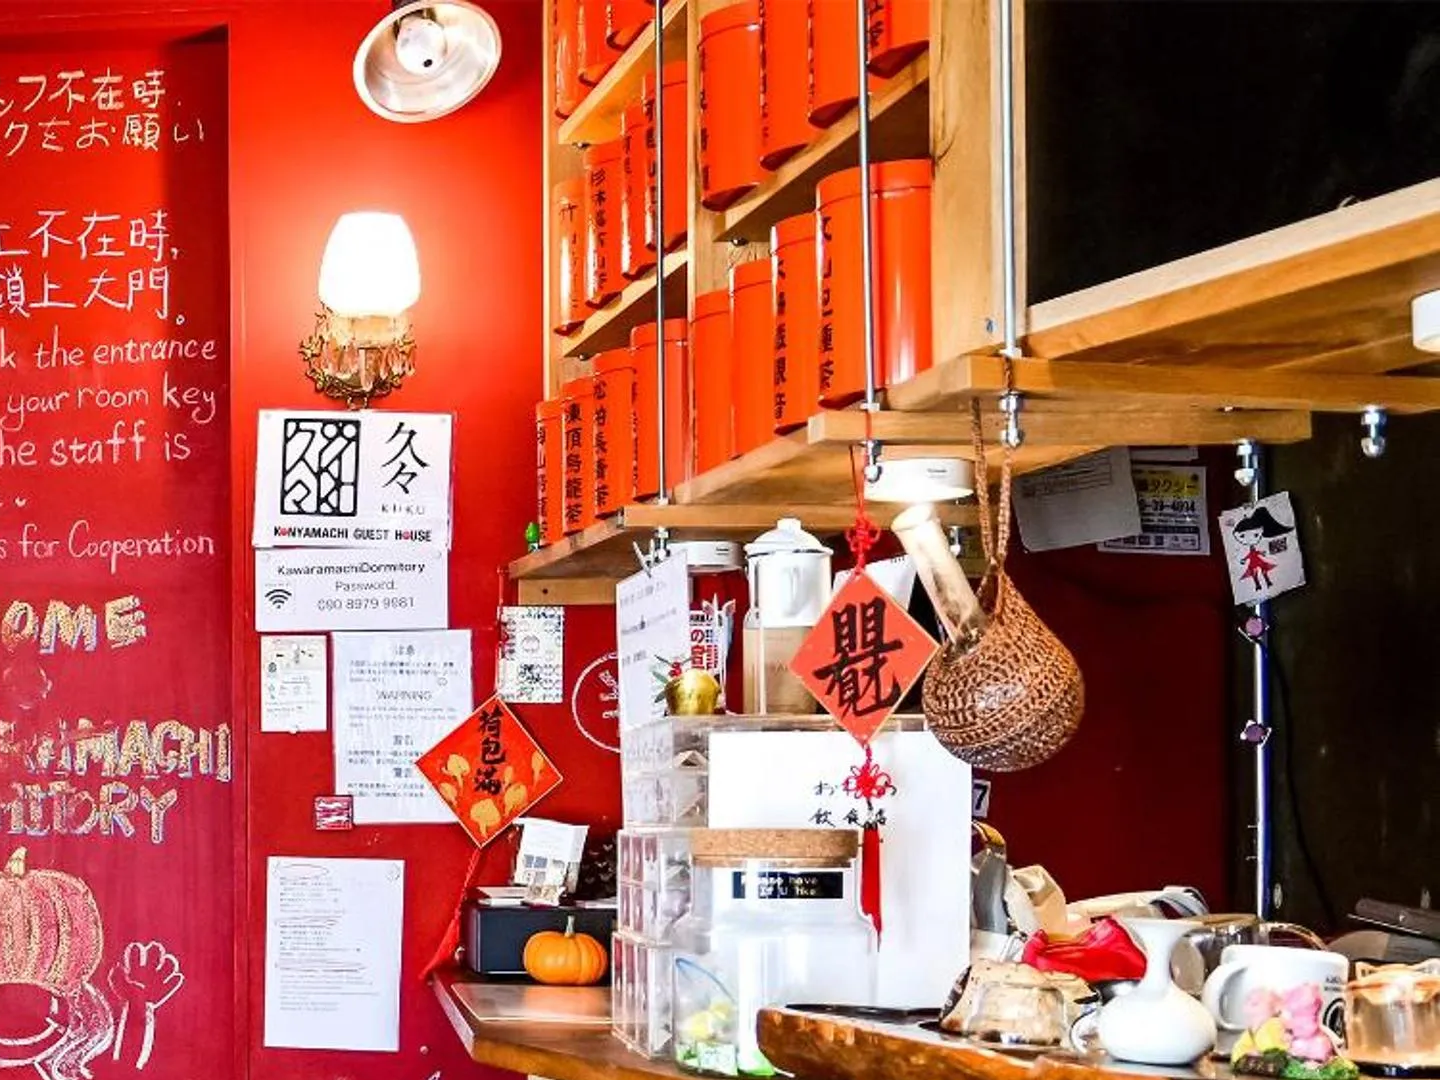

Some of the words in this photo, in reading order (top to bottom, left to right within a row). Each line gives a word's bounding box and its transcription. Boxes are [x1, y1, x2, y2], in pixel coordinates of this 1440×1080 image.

[34, 325, 85, 368] the
[94, 337, 218, 366] entrance
[77, 385, 149, 410] room
[162, 371, 216, 423] key
[49, 420, 146, 466] staff
[164, 432, 192, 462] is
[17, 523, 60, 559] for
[67, 520, 216, 575] Cooperation
[274, 525, 349, 540] KONYAMACHI
[353, 527, 389, 541] GUEST
[395, 528, 432, 542] HOUSE
